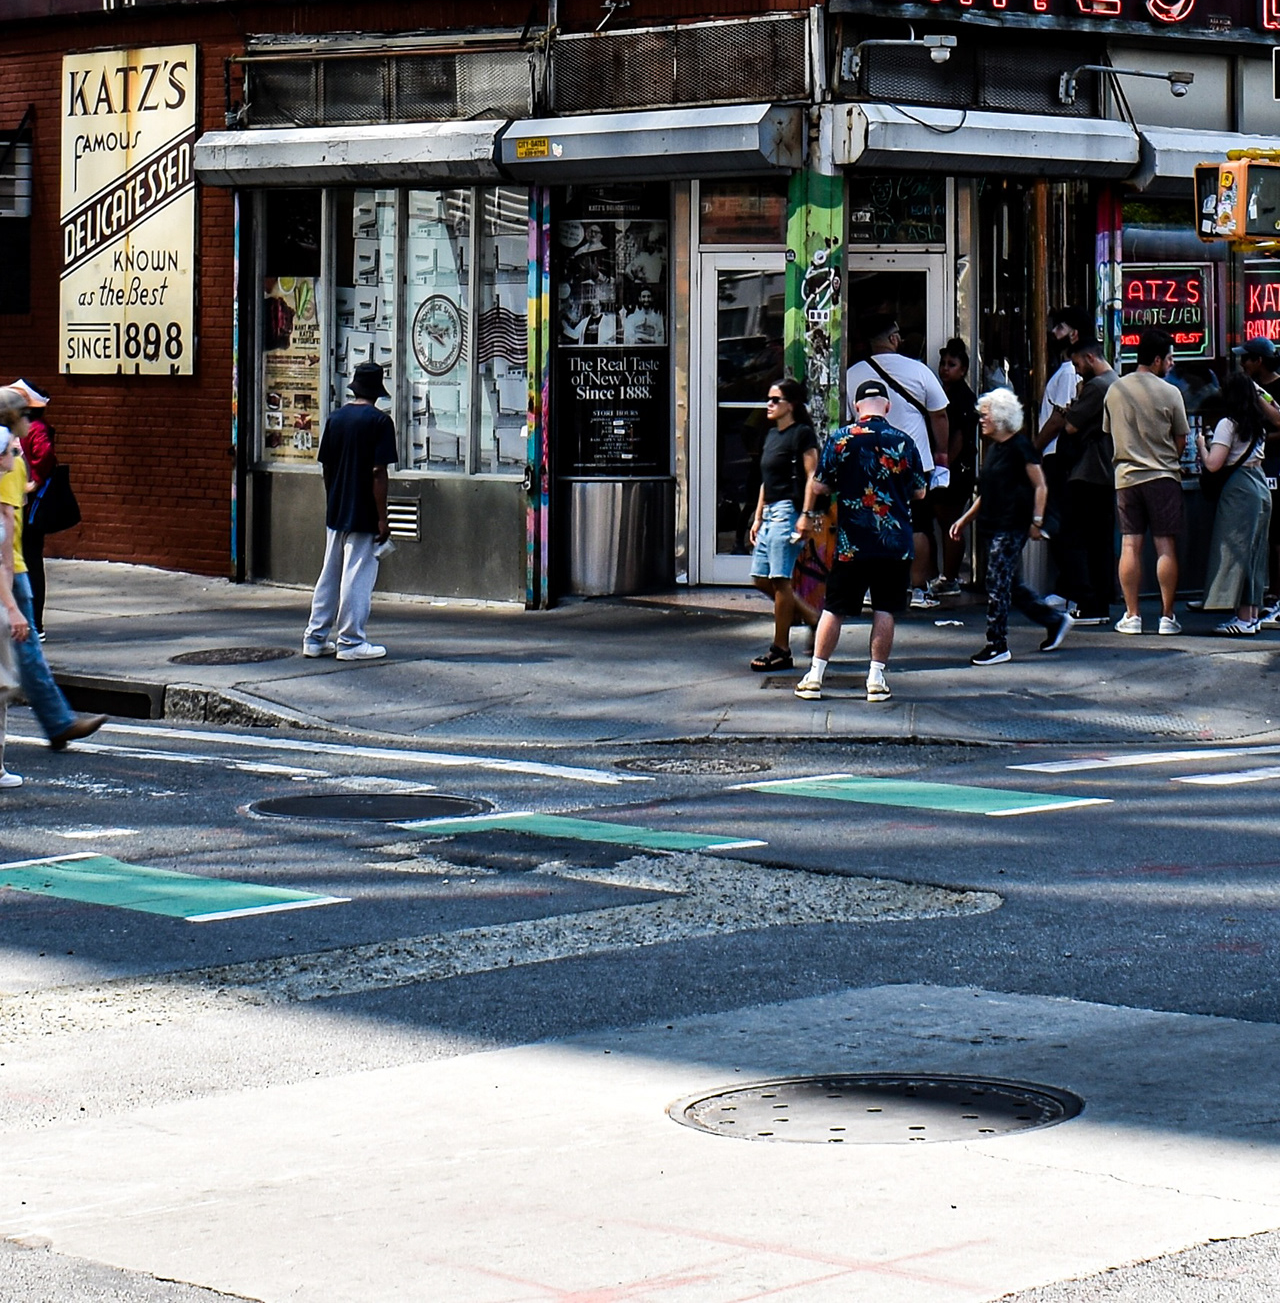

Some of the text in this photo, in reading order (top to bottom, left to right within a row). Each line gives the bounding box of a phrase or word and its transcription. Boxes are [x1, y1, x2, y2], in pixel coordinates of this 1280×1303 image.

[68, 60, 188, 117] KATZ'S
[64, 142, 190, 265] DELICATESSEN
[113, 249, 179, 272] KNOWN
[78, 277, 169, 307] as the Best
[1121, 307, 1201, 326] LICATESSEN
[67, 322, 183, 362] SINCE 1898
[568, 357, 659, 371] The Real Taste
[571, 371, 656, 386] of New York.
[576, 386, 652, 400] Since 1888.
